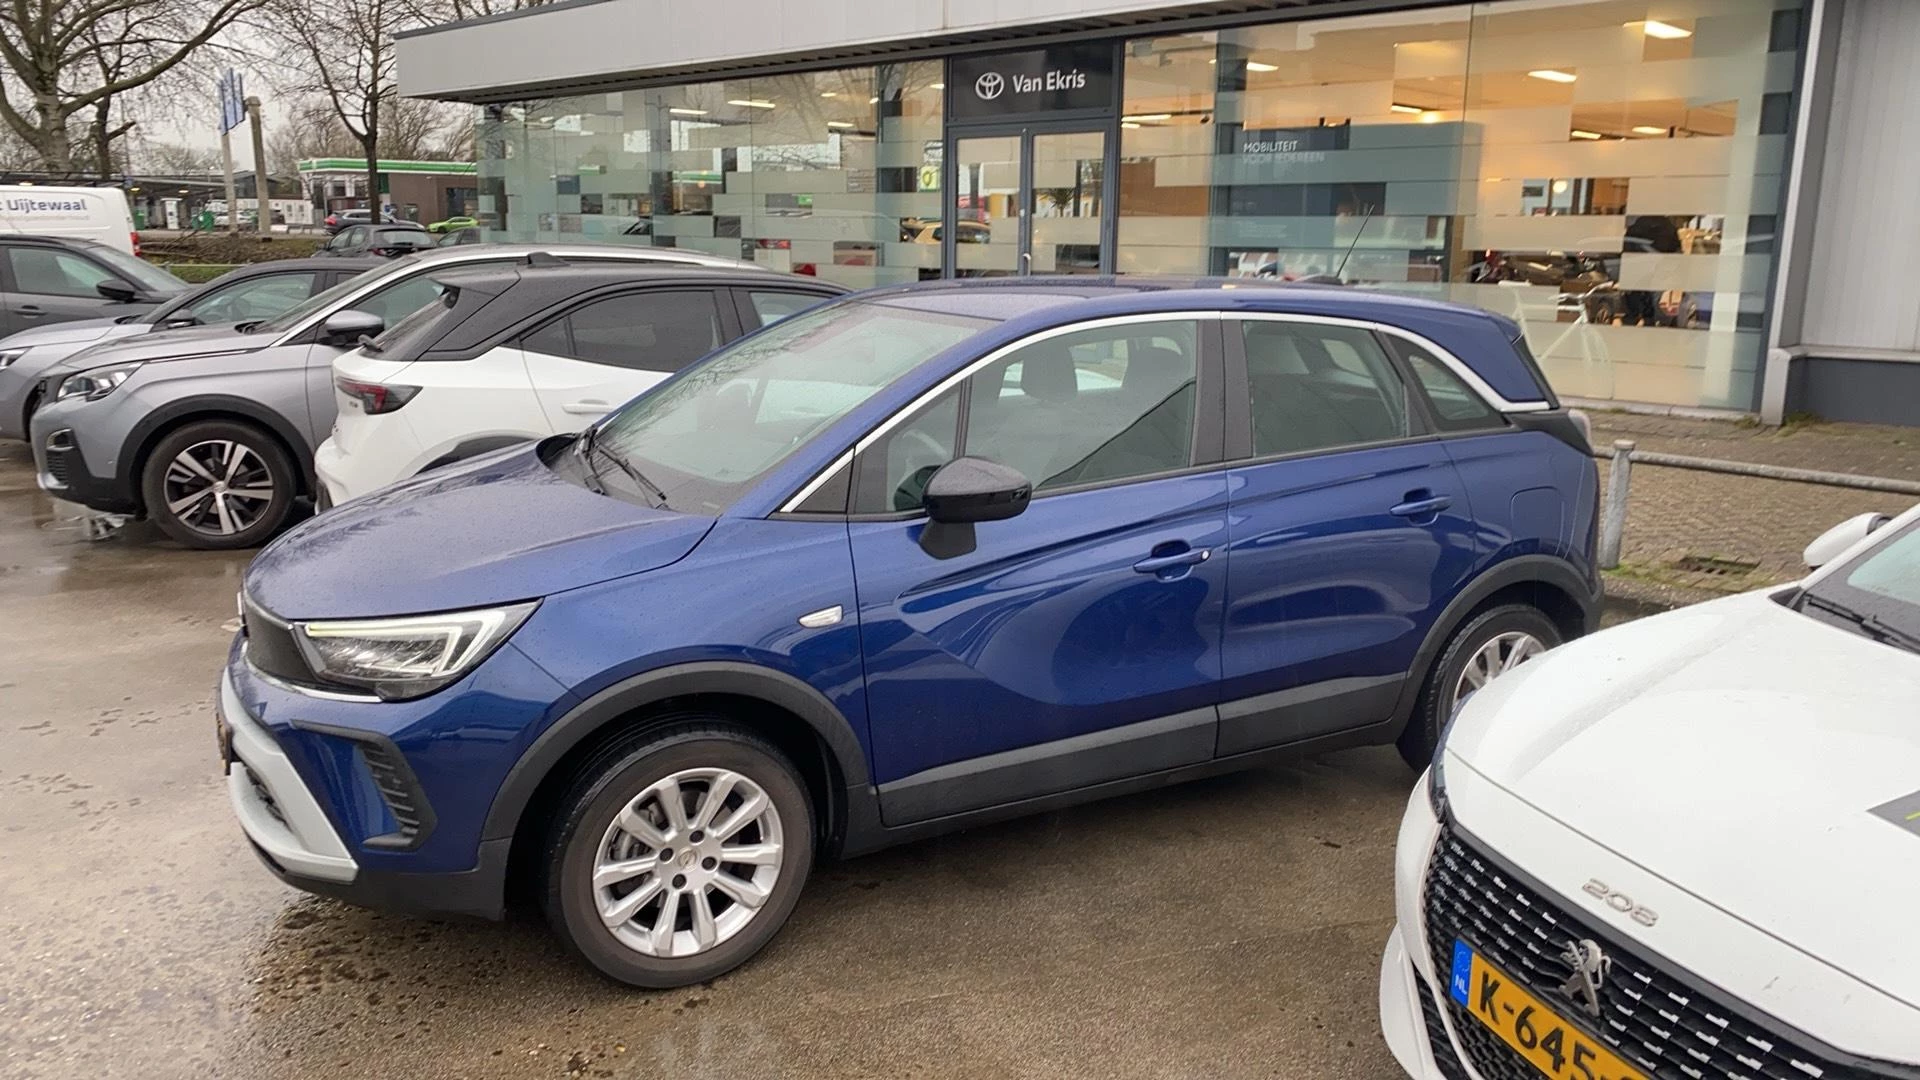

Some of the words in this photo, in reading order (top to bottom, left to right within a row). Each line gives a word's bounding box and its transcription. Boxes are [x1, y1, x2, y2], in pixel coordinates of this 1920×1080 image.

[1012, 74, 1042, 93] Van
[1046, 69, 1086, 91] Ekris
[1243, 140, 1298, 153] MOBILITEIT
[7, 199, 88, 213] Uijtewaal
[1582, 878, 1659, 927] 208
[1454, 974, 1468, 995] NL
[1479, 970, 1633, 1080] K-645
